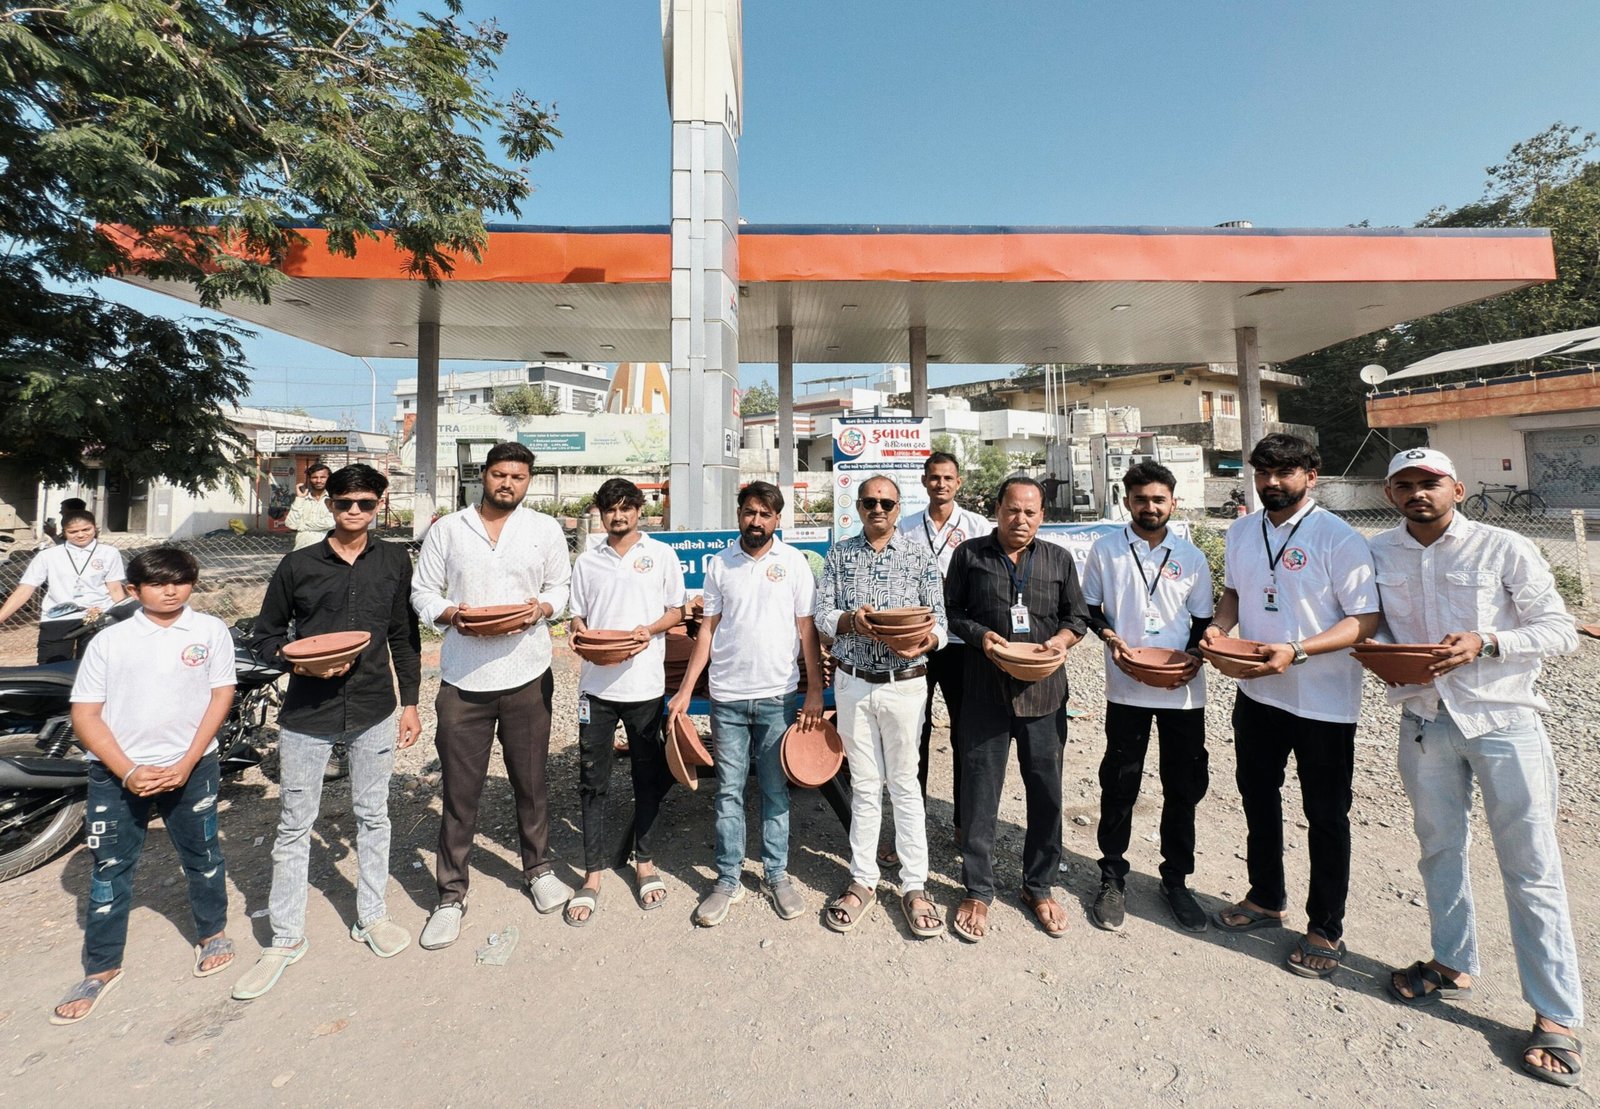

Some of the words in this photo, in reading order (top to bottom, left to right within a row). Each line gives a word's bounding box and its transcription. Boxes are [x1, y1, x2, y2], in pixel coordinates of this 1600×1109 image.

[438, 424, 497, 433] TRAGREEN
[869, 429, 920, 444] કુબાવત
[671, 539, 705, 550] પક્ષીઓ
[707, 539, 725, 549] માટે
